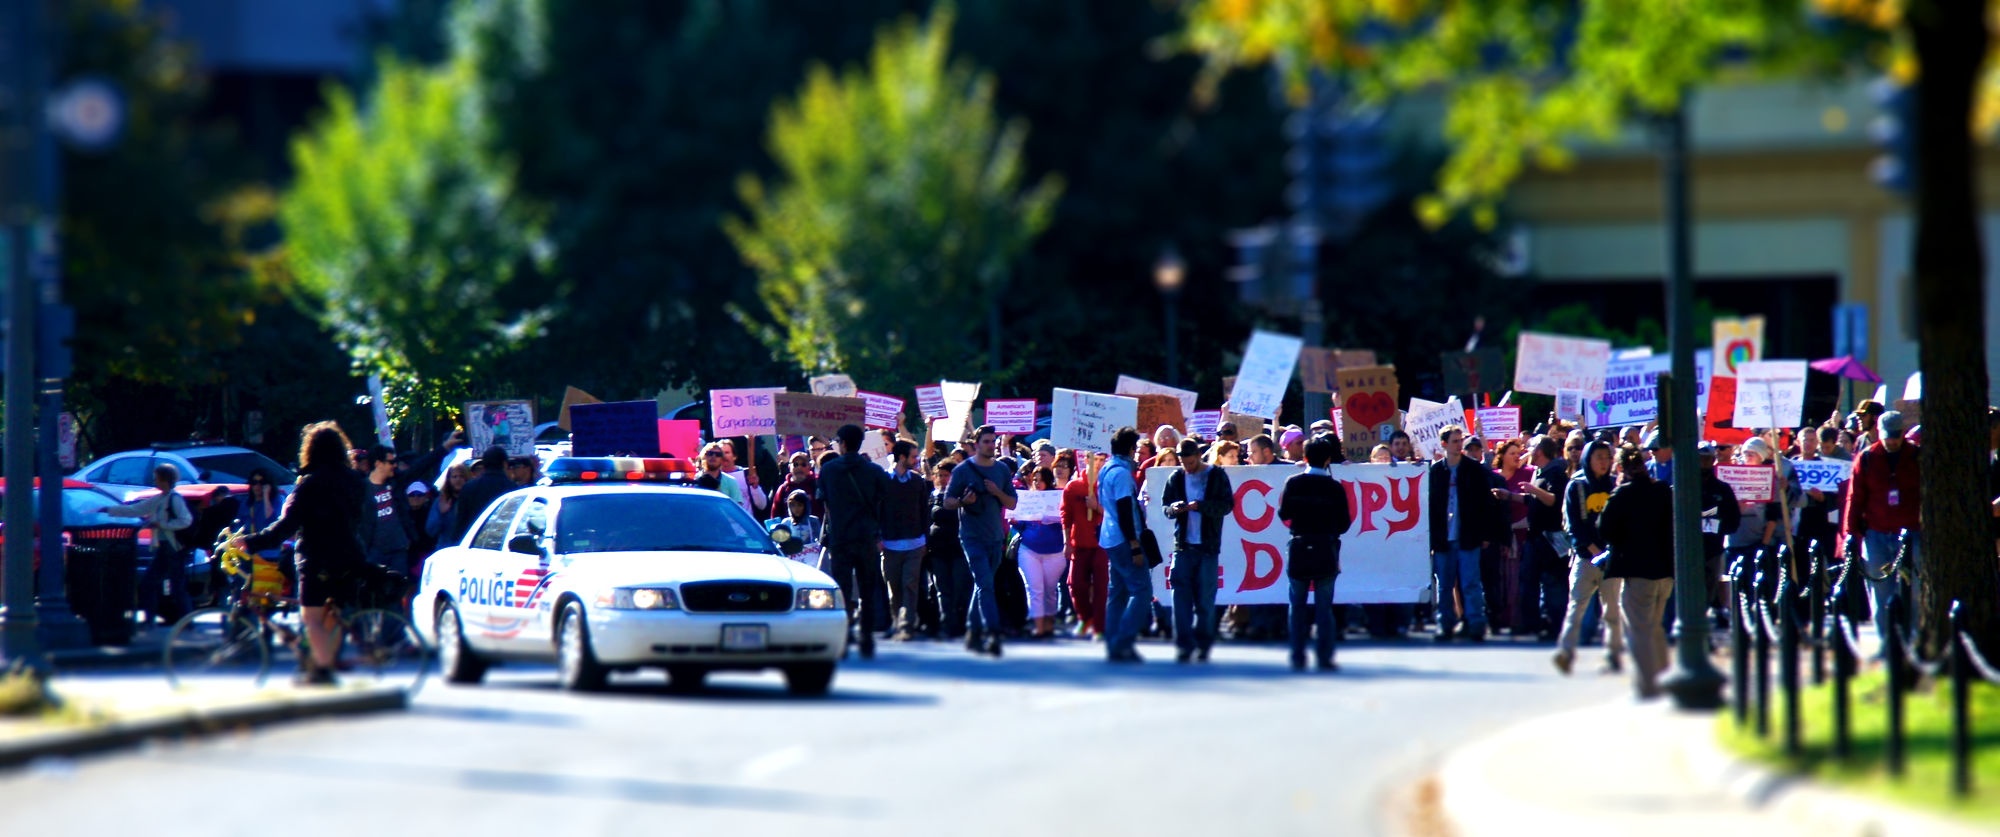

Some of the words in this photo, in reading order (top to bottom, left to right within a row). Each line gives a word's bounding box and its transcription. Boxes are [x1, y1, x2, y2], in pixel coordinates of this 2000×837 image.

[1345, 376, 1387, 389] MAKE
[1605, 374, 1640, 391] HUMAN
[720, 394, 744, 408] END
[745, 394, 770, 407] THIS
[1603, 387, 1659, 406] CORPORAT
[1350, 431, 1378, 443] NOT
[1797, 470, 1843, 485] 99%
[374, 491, 392, 503] YES
[377, 506, 393, 518] NO
[459, 577, 514, 607] POLICE
